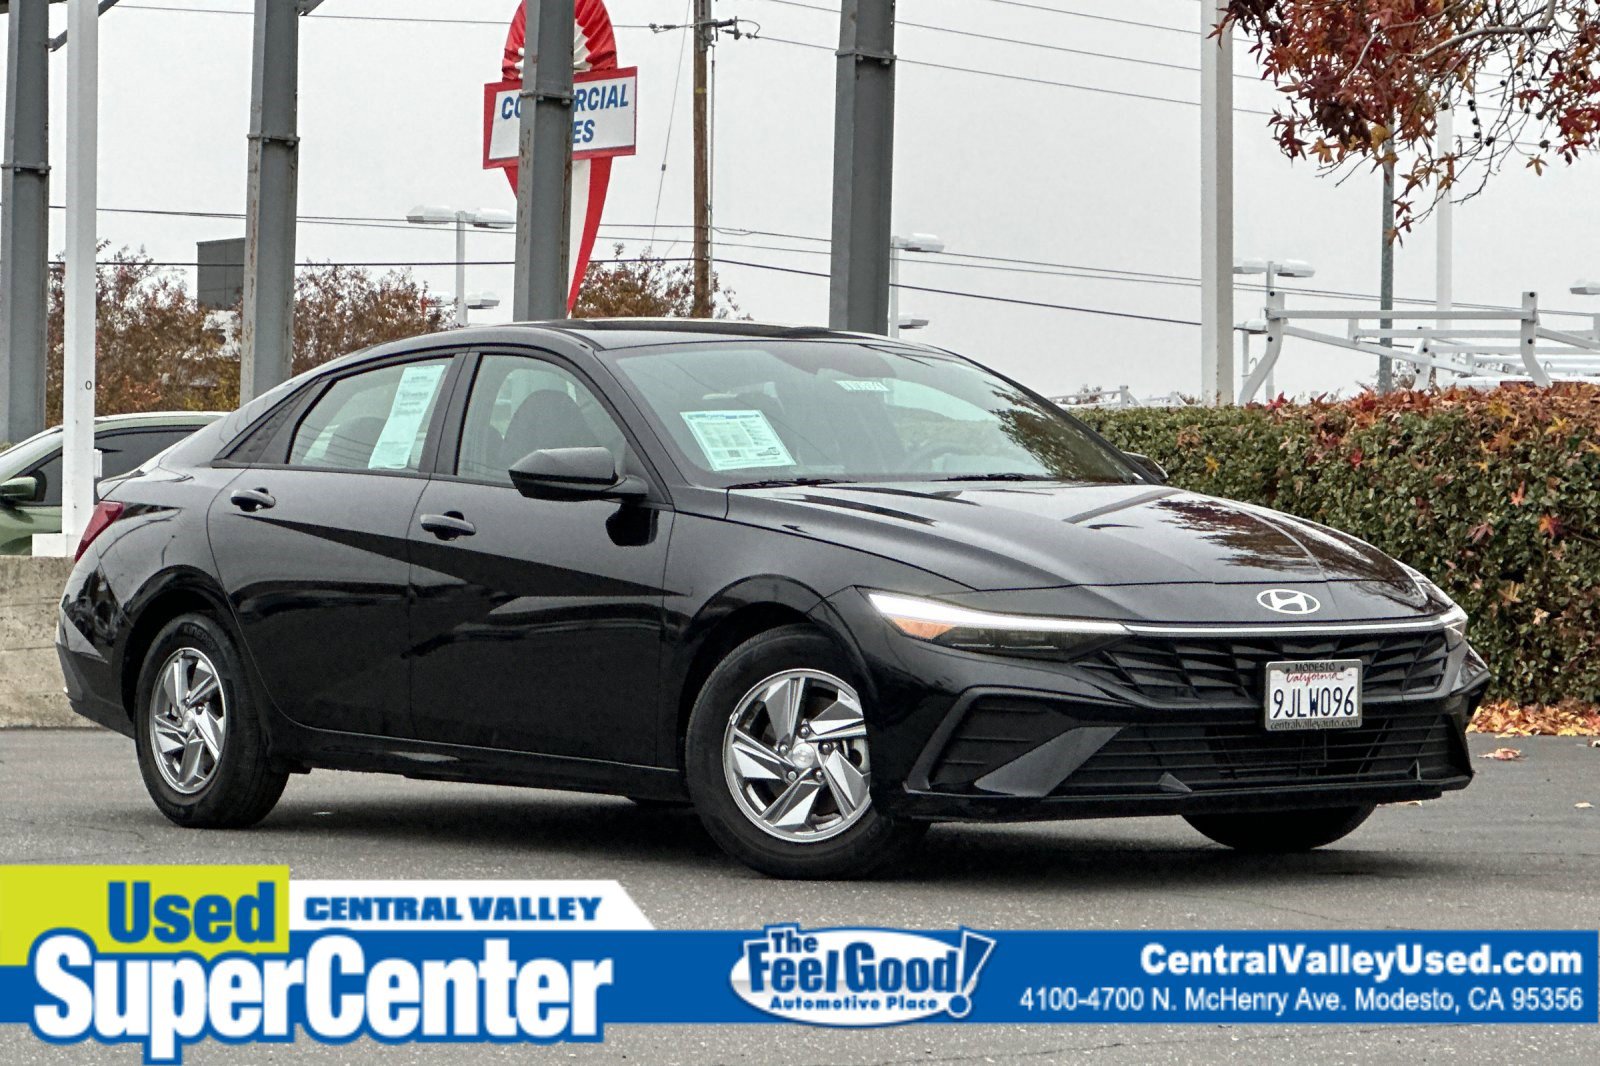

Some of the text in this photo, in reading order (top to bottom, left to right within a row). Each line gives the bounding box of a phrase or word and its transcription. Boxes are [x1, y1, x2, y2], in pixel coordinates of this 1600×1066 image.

[502, 84, 629, 119] CRCIAL
[1295, 662, 1336, 672] MODESTO
[1286, 672, 1344, 686] California
[1273, 686, 1355, 718] 9JLW096
[1270, 719, 1359, 730] centralvalleyauto.com
